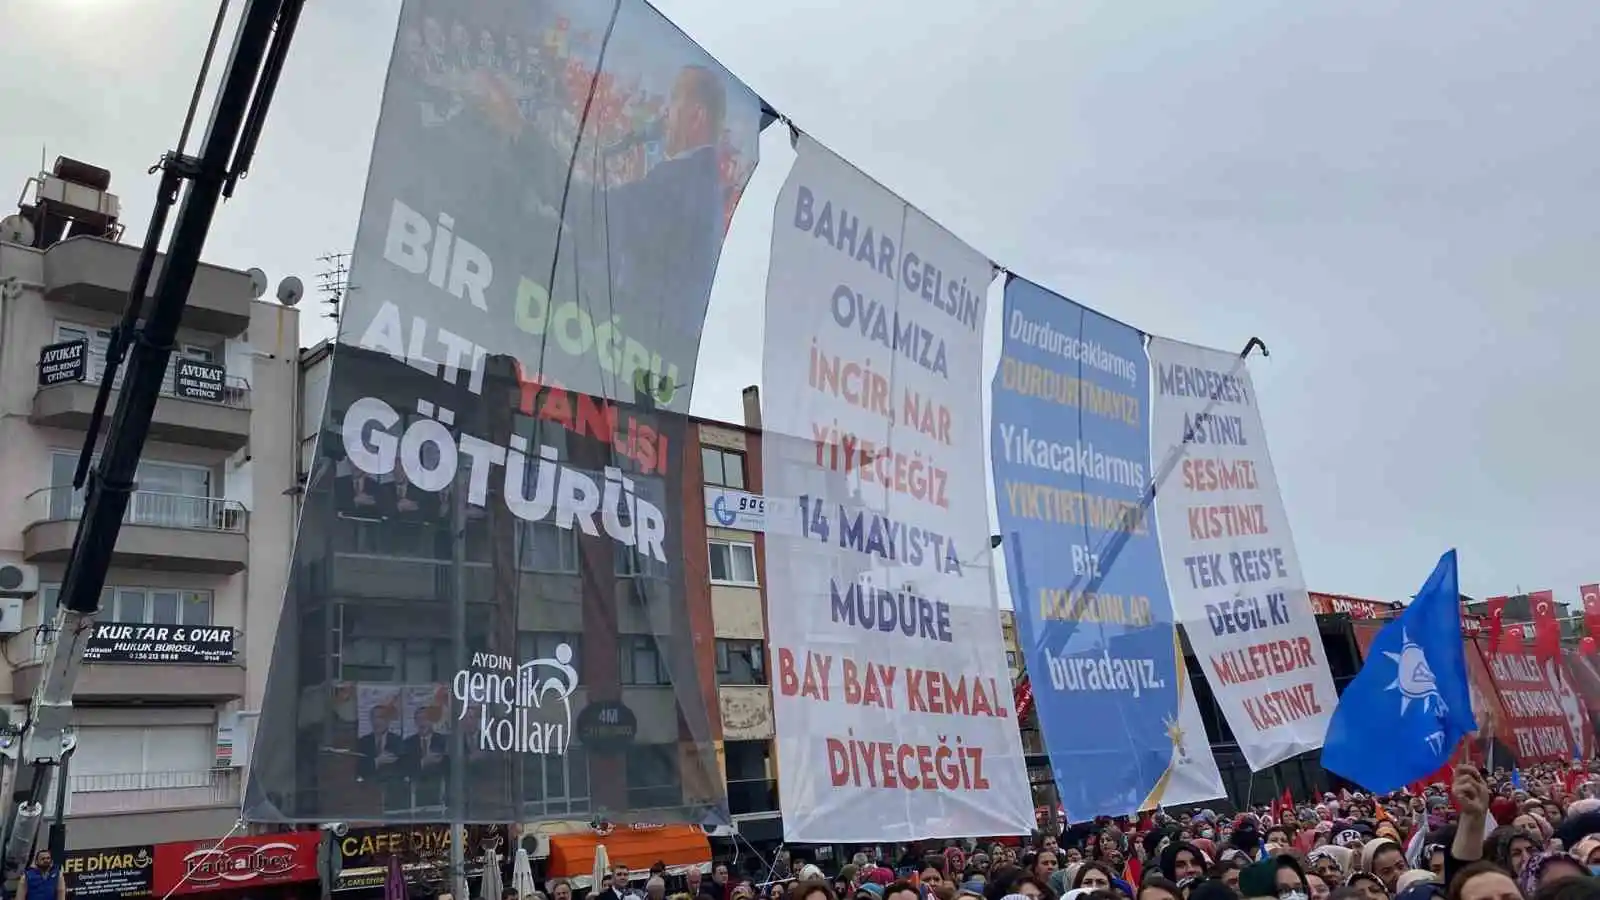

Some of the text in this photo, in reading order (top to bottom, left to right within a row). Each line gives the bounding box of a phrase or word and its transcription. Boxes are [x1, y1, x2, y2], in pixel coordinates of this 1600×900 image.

[794, 185, 981, 333] BAHAR GELSİN
[383, 198, 680, 405] BİR DOĞRU
[43, 344, 83, 363] AVUKAT
[831, 284, 949, 380] OVAMIZA
[1010, 309, 1138, 389] Durduracaklarmış
[180, 363, 224, 381] AVUKAT
[360, 300, 669, 477] ALTI YANLIŞI
[808, 335, 952, 446] İNCİR, NAR
[1181, 411, 1249, 446] ASTINIZ
[341, 396, 669, 565] GÖTÜRÜR
[812, 418, 950, 509] YİYECEĞİZ
[999, 422, 1145, 499] Yıkacaklarmış
[1182, 456, 1260, 492] SESİMİZİ
[799, 493, 963, 578] 14 MAYIS'TA
[1187, 503, 1269, 541] KISTINIZ
[1070, 544, 1102, 580] Biz
[1183, 547, 1289, 590] TEK REİS'E
[97, 626, 231, 643] KURTAR & OYAR
[829, 574, 953, 643] MÜDÜRE
[1204, 592, 1268, 637] DEĞİL
[1267, 591, 1291, 626] Kİ
[113, 642, 152, 652] HUKUK
[154, 643, 195, 653] BÜROSU
[471, 652, 513, 671] AYDIN
[1046, 646, 1166, 698] buradayız.
[1209, 636, 1318, 688] MİLLETEDİR
[453, 665, 541, 721] gençlik
[777, 646, 833, 702] BAY
[843, 658, 897, 710] BAY
[905, 667, 1009, 719] KEMAL
[1242, 682, 1323, 732] KASTINIZ
[479, 703, 564, 756] kolları
[1512, 727, 1541, 758] TEK
[825, 727, 990, 793] DİYECEĞİZ
[87, 852, 134, 871] DİYAR
[341, 831, 402, 858] CAFE
